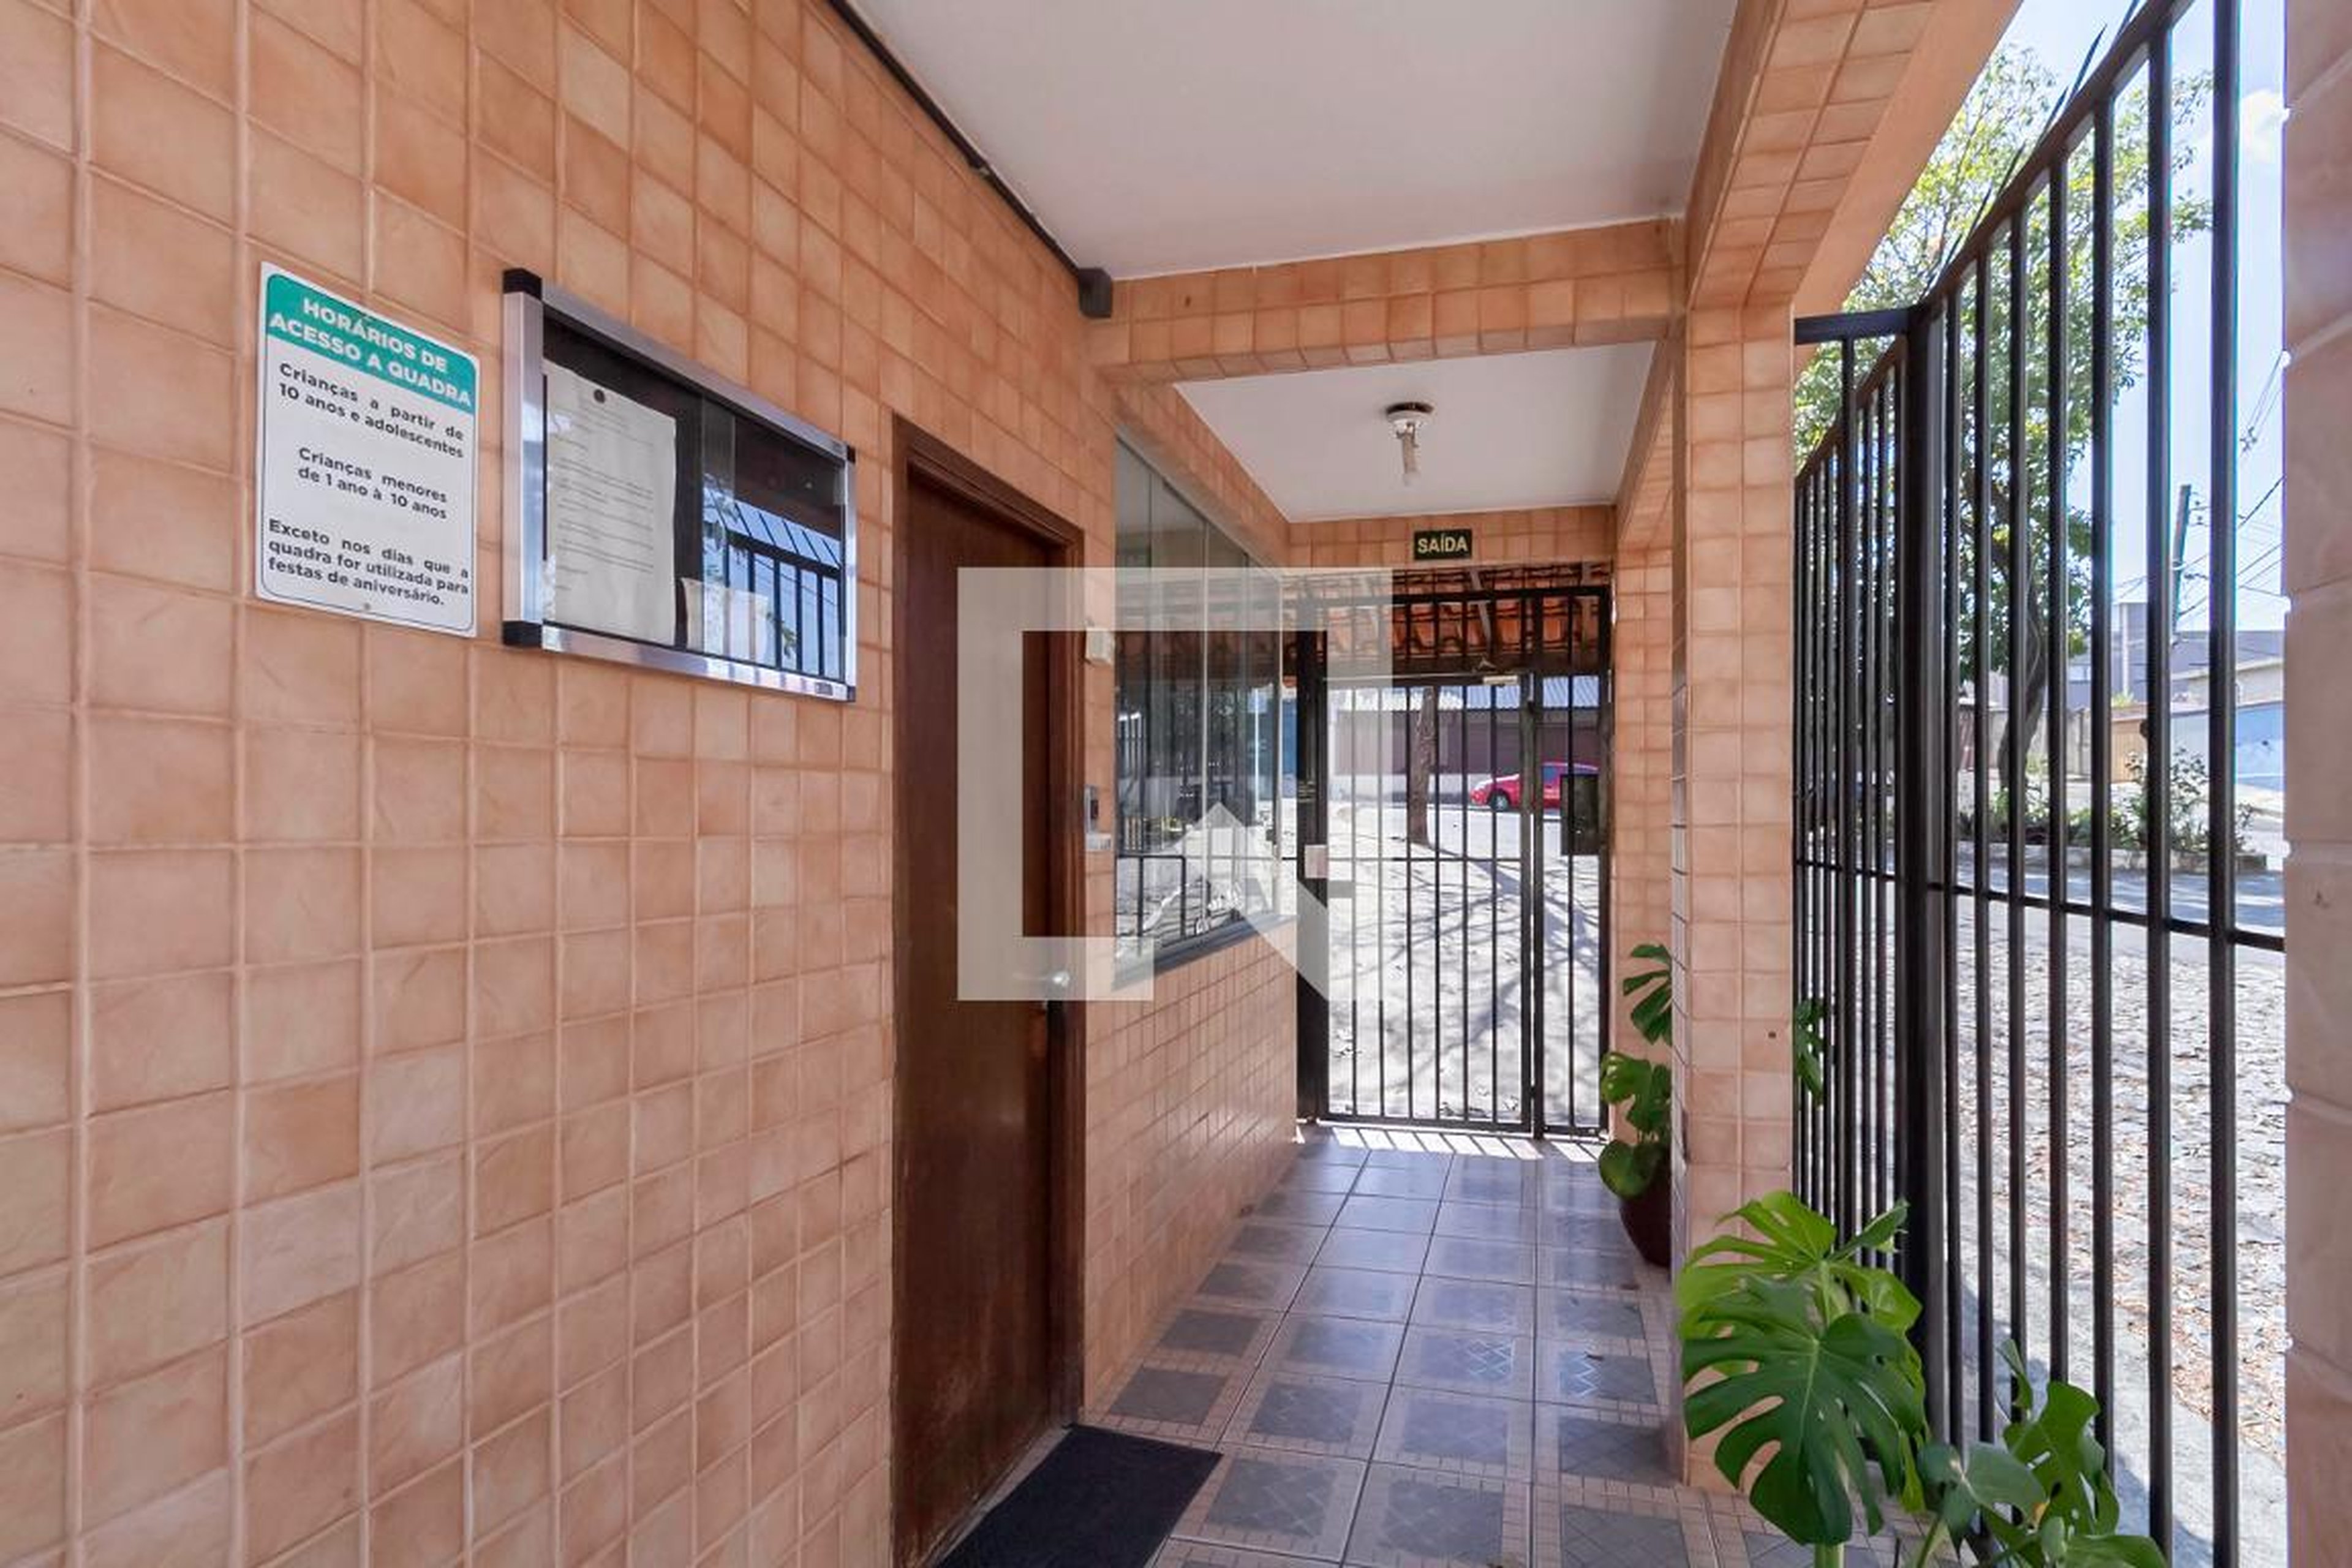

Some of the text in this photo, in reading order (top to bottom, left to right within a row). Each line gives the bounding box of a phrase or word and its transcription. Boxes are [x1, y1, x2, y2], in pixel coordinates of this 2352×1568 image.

[270, 312, 471, 407] ACESSO A QUADRA
[303, 296, 448, 373] HORÁRIOS DE
[279, 363, 464, 440] Crianças a partir de
[279, 382, 464, 458] 10 anos e adolescentes
[298, 467, 320, 483] de
[326, 473, 332, 486] 1
[337, 479, 368, 496] ano
[390, 493, 408, 507] 10
[412, 502, 447, 519] anos
[299, 447, 447, 503] Crianças menores
[269, 518, 469, 578] Exceto nos dias que a
[269, 540, 468, 594] quadra for utilizada para
[1417, 532, 1469, 554] SAÍDA
[268, 557, 445, 606] festas de aniversário.
